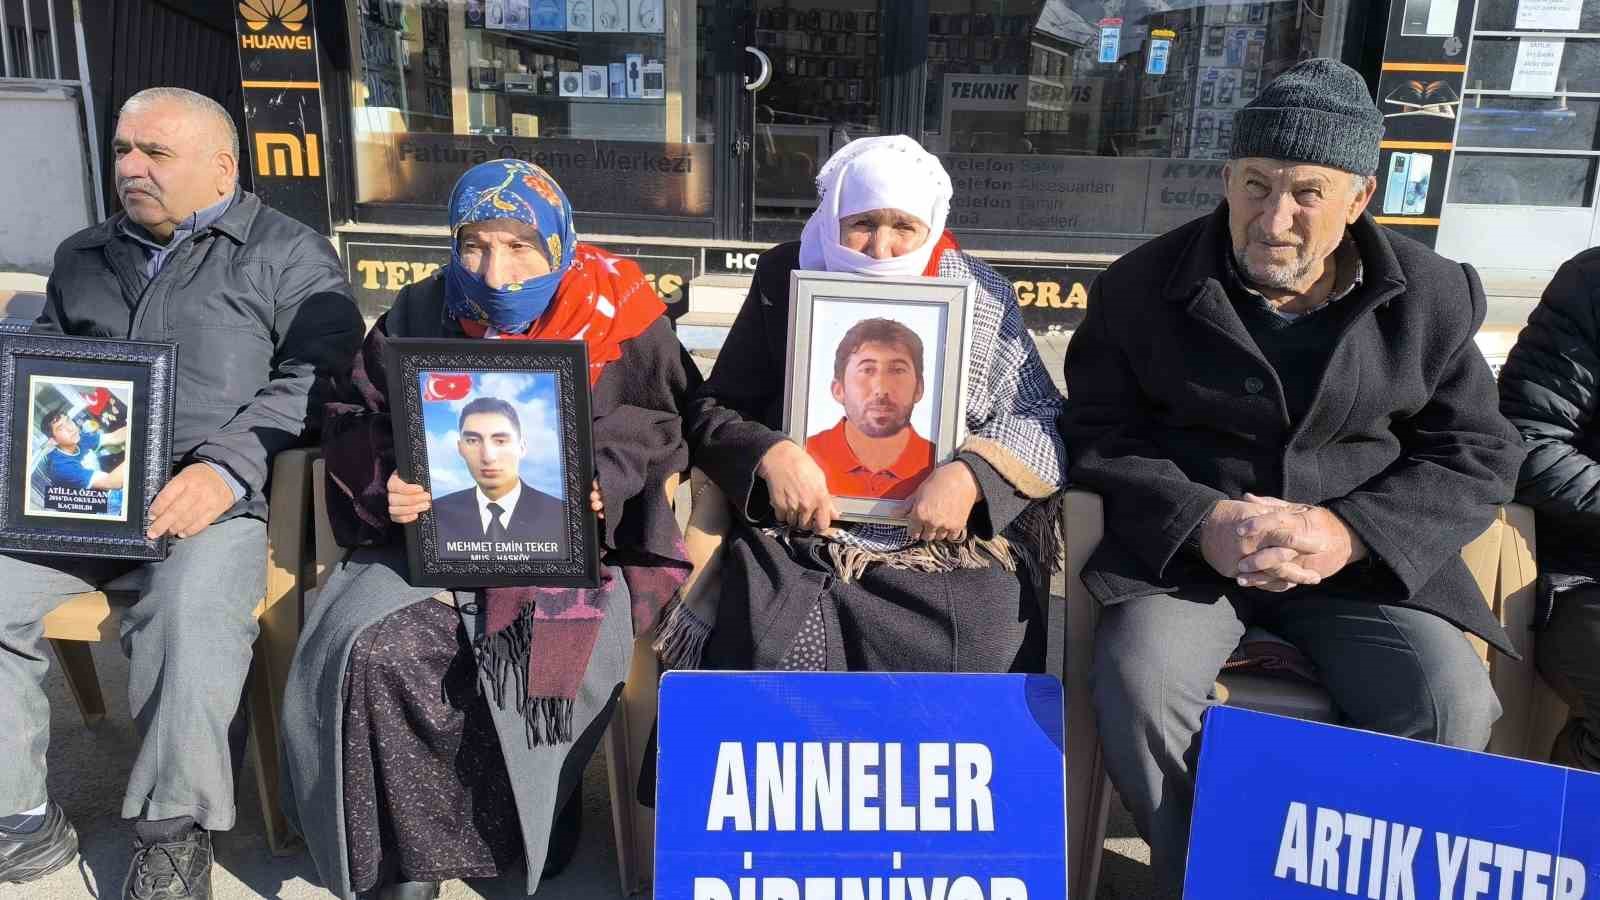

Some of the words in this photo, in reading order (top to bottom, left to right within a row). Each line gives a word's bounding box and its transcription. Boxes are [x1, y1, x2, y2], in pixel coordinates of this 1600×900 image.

[242, 35, 312, 49] HUAWEI
[594, 149, 693, 173] Merkezi
[79, 488, 109, 498] ÖZCAN
[446, 541, 493, 552] MEHMET
[495, 540, 522, 552] EMİN
[524, 542, 559, 553] TEKER
[705, 741, 996, 832] ANNELER
[1273, 801, 1423, 900] ARTIK
